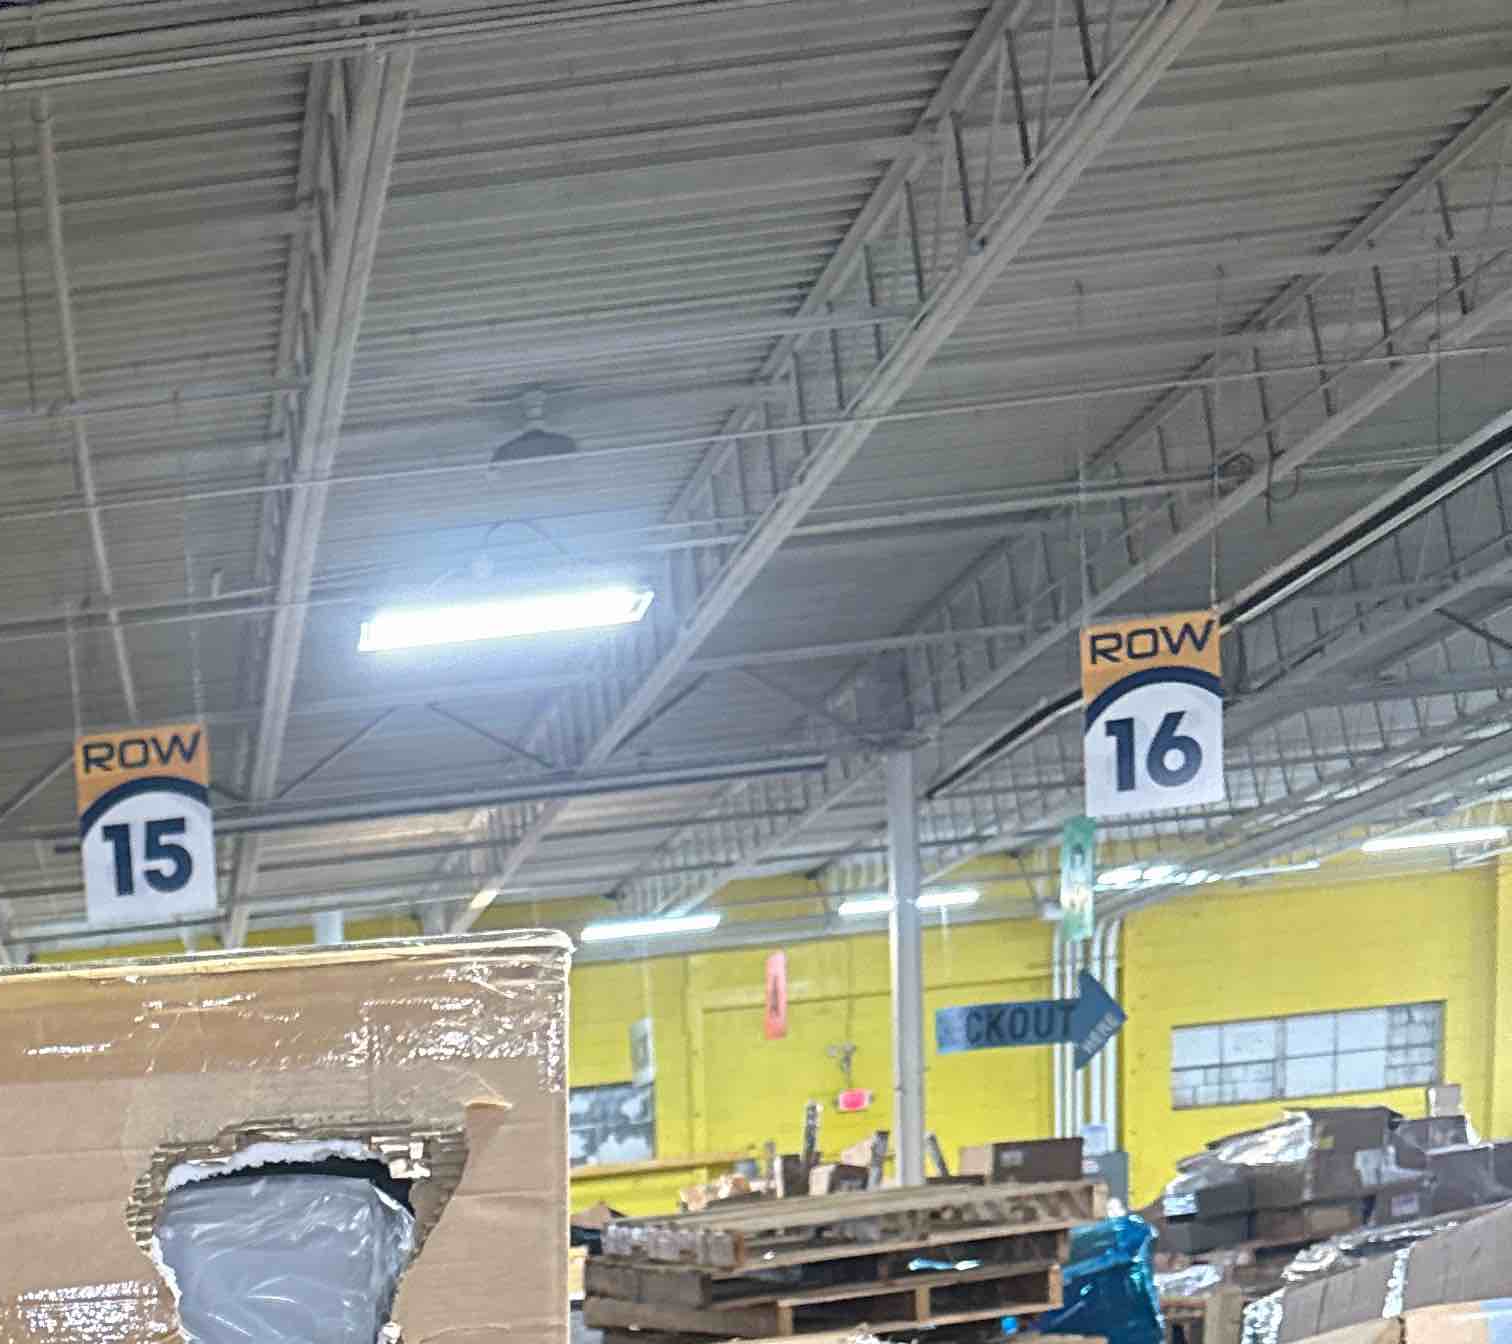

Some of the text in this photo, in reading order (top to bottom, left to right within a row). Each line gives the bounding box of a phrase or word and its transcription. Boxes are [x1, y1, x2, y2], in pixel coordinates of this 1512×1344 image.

[1091, 620, 1215, 664] ROW
[83, 731, 201, 774] ROW
[1104, 711, 1203, 792] 16
[102, 817, 193, 897] 15
[964, 1002, 1077, 1046] CKOUT
